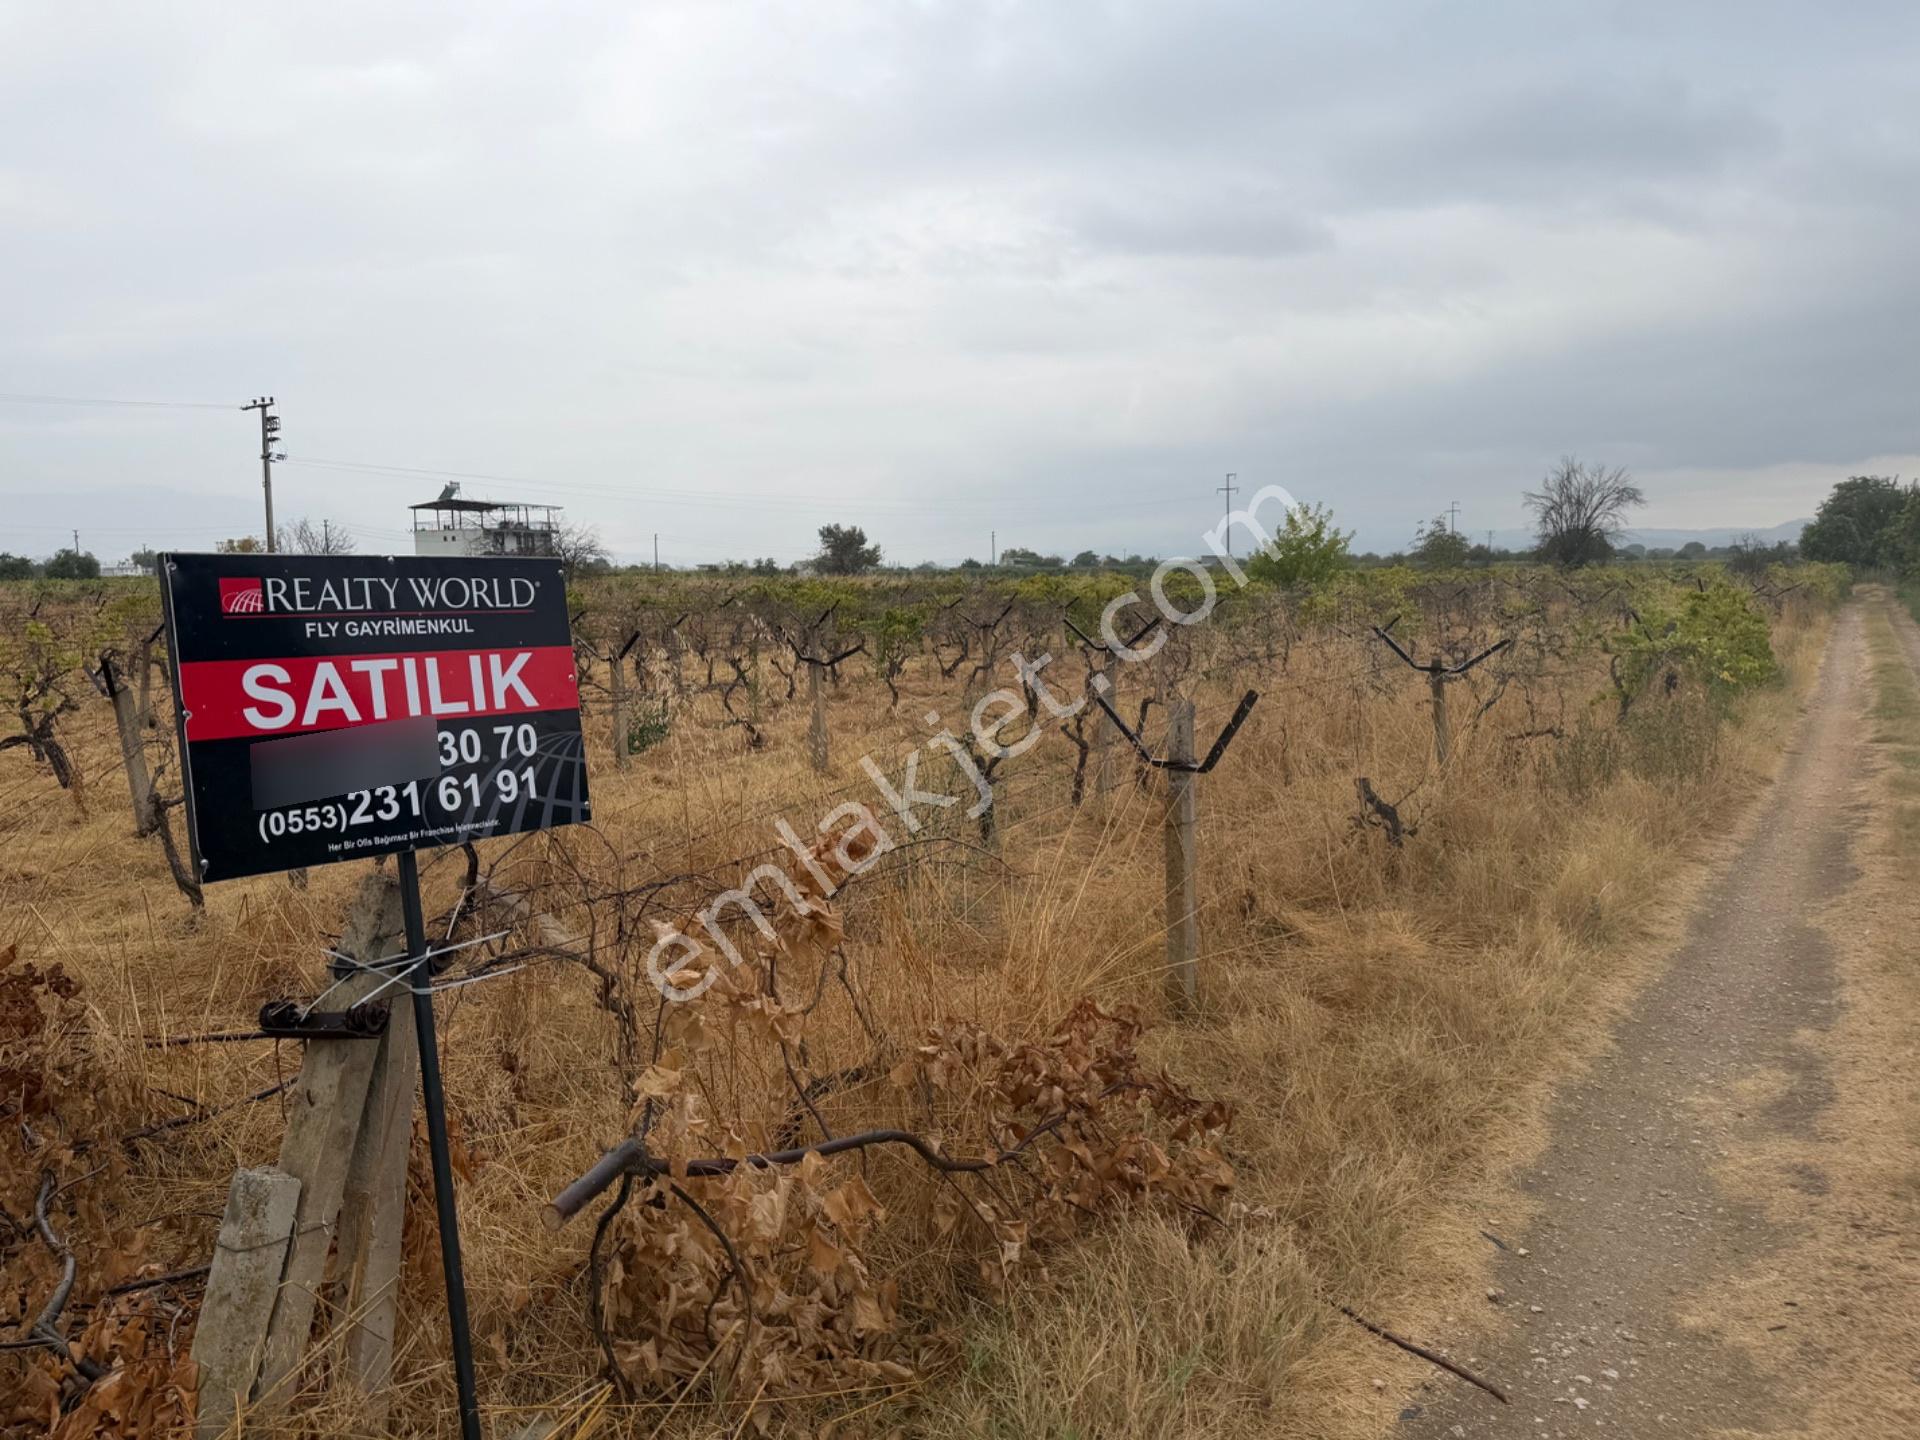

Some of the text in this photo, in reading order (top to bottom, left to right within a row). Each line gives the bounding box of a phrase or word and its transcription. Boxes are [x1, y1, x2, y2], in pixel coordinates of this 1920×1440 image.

[265, 577, 537, 612] REALTY WORLD
[305, 617, 474, 638] FLY GAYRİMENKUL
[242, 652, 540, 730] SATILIK
[437, 723, 538, 767] 30 70
[438, 773, 481, 812] 61
[496, 766, 538, 804] 91
